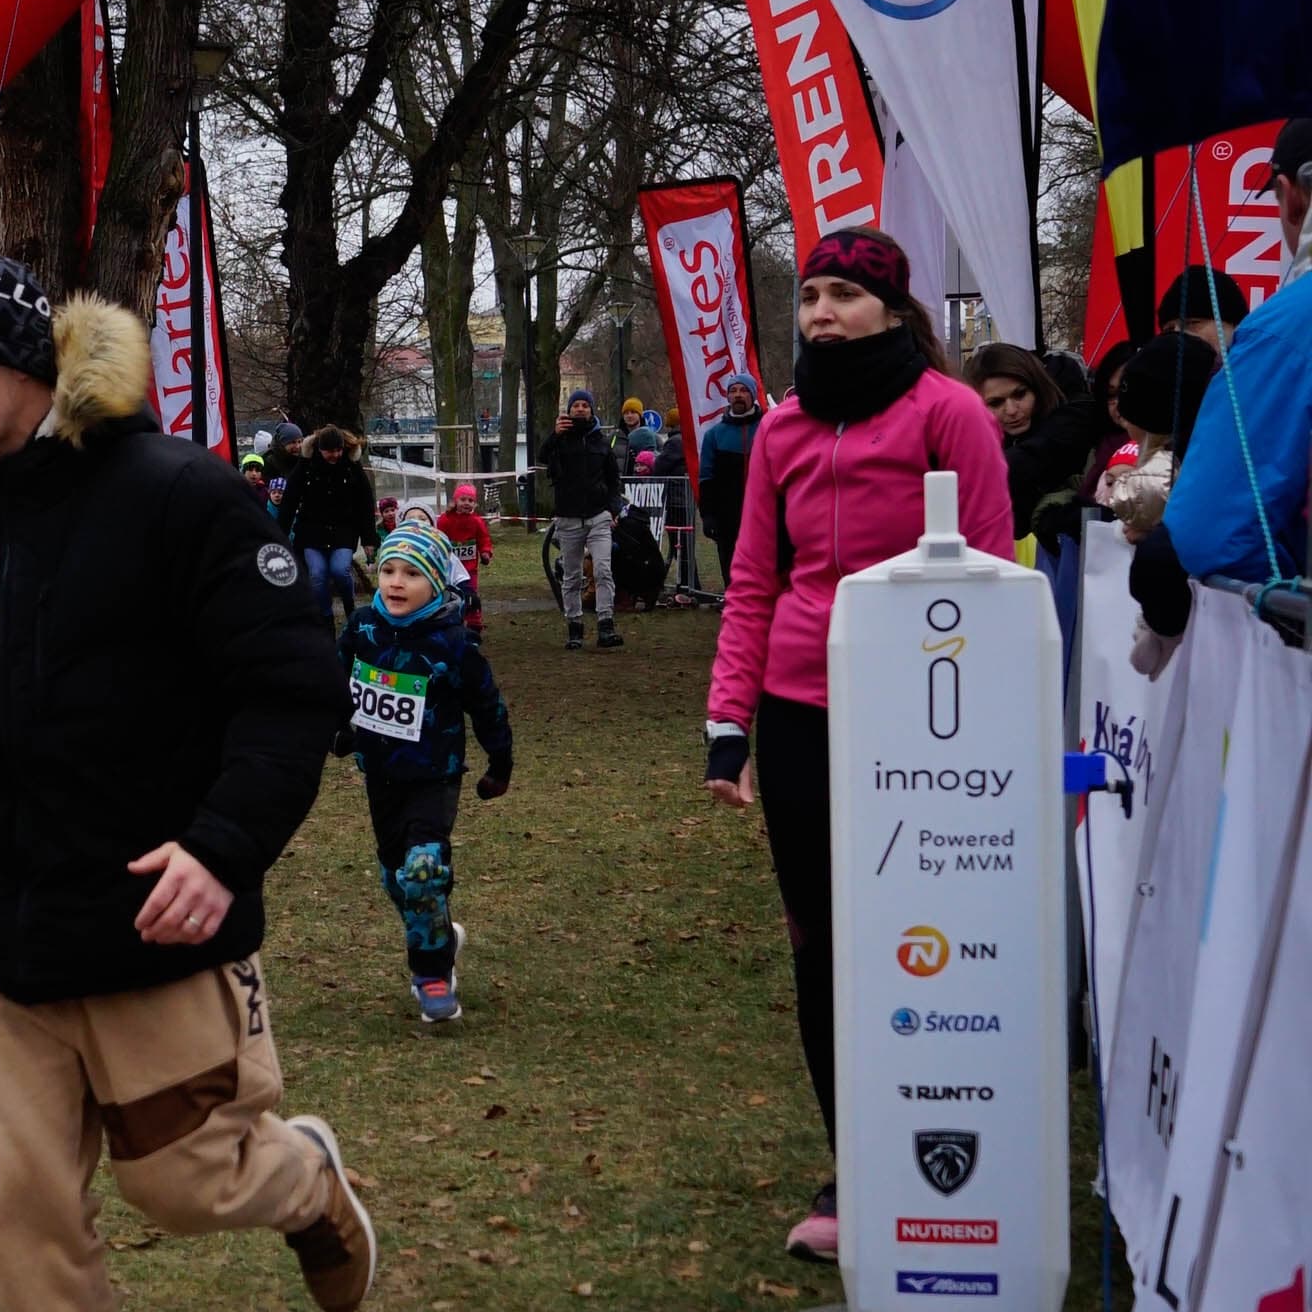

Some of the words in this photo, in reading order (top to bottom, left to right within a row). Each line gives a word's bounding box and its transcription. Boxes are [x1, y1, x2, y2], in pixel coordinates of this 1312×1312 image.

[875, 761, 1014, 797] innogy
[919, 828, 1015, 847] Powered
[919, 853, 947, 876] by
[955, 853, 1014, 871] MVM
[959, 942, 998, 960] NN
[924, 1011, 1001, 1033] ŠKODA
[901, 1223, 994, 1240] NUTREND
